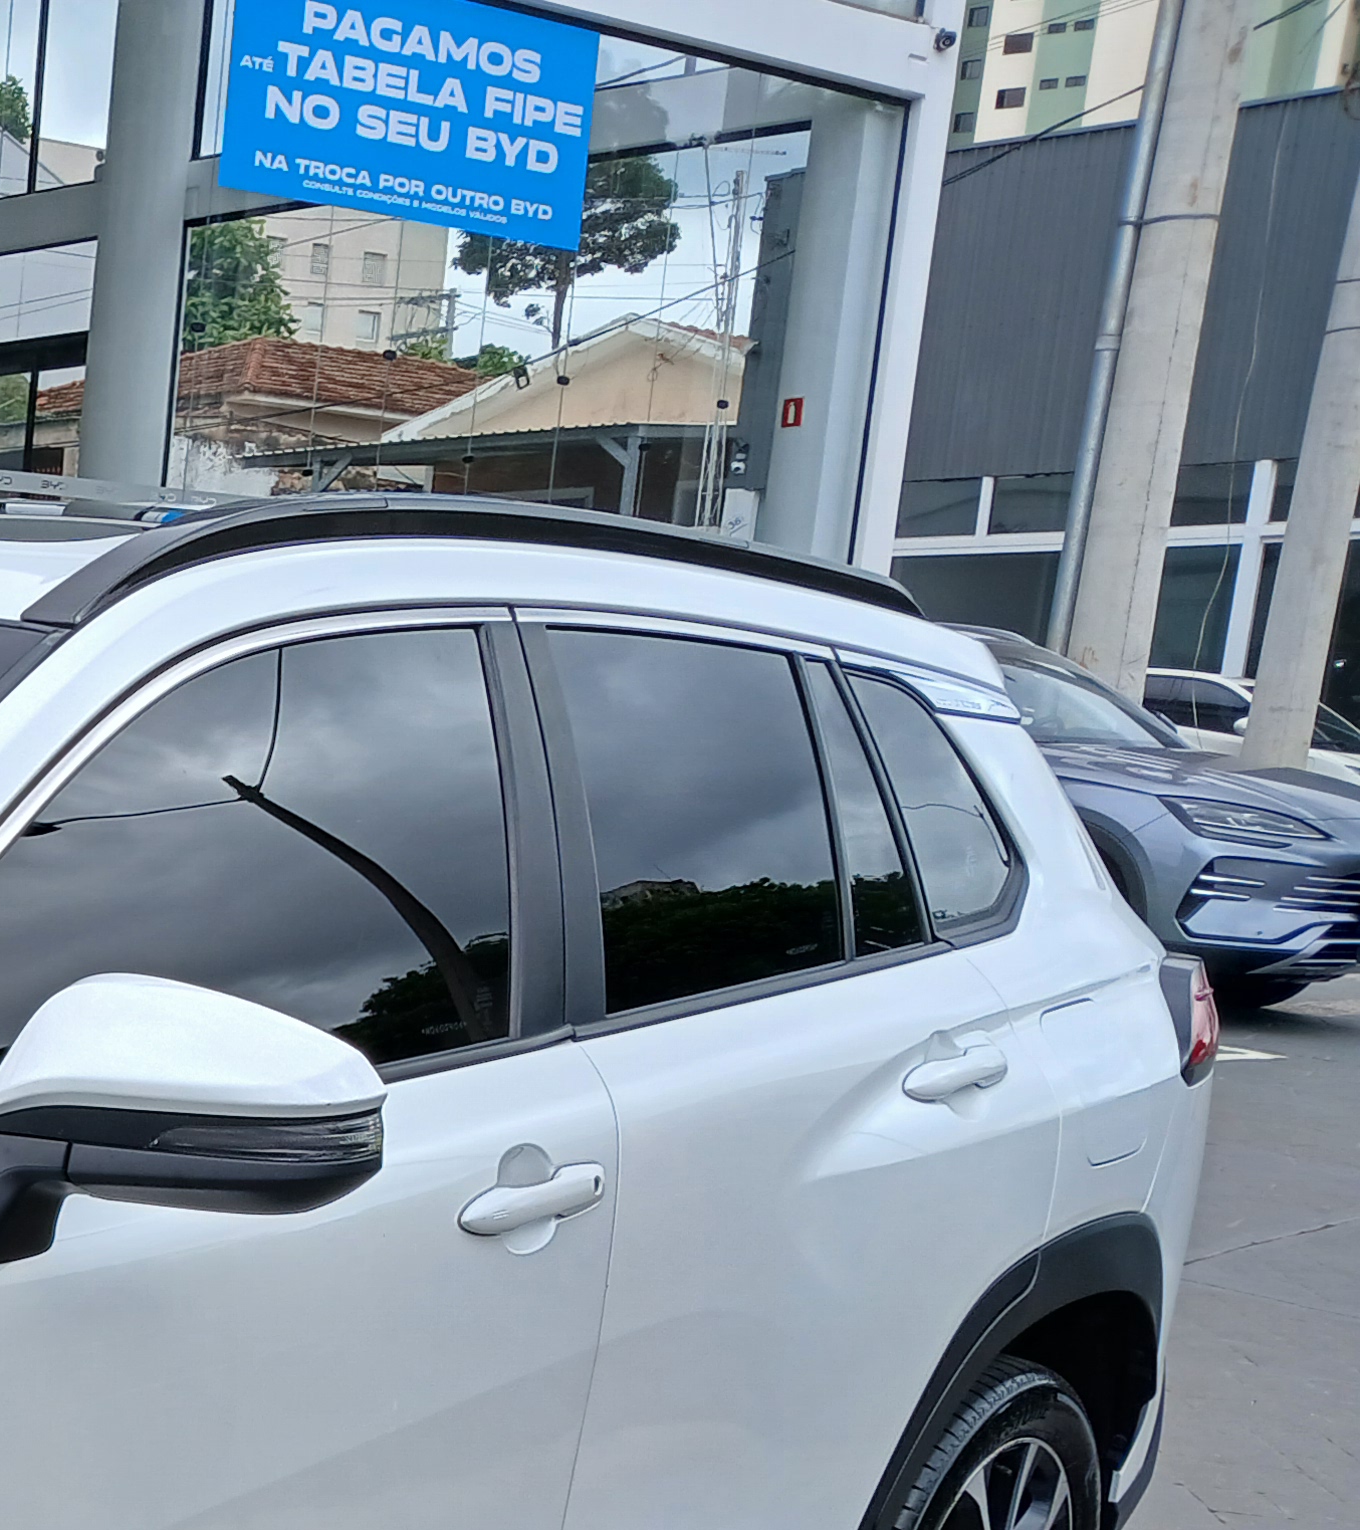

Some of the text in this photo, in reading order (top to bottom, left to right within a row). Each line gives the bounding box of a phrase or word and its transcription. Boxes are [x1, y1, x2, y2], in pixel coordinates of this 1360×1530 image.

[302, 0, 542, 83] PAGAMOS
[239, 41, 584, 137] ATÉ TABELA FIPE
[265, 85, 558, 174] NO SEU BYD
[254, 151, 554, 221] NA TROCA POR OUTRO BYD
[302, 180, 355, 196] CONSULTE
[421, 201, 467, 217] MODELOS
[468, 208, 508, 225] VÁLIDOS
